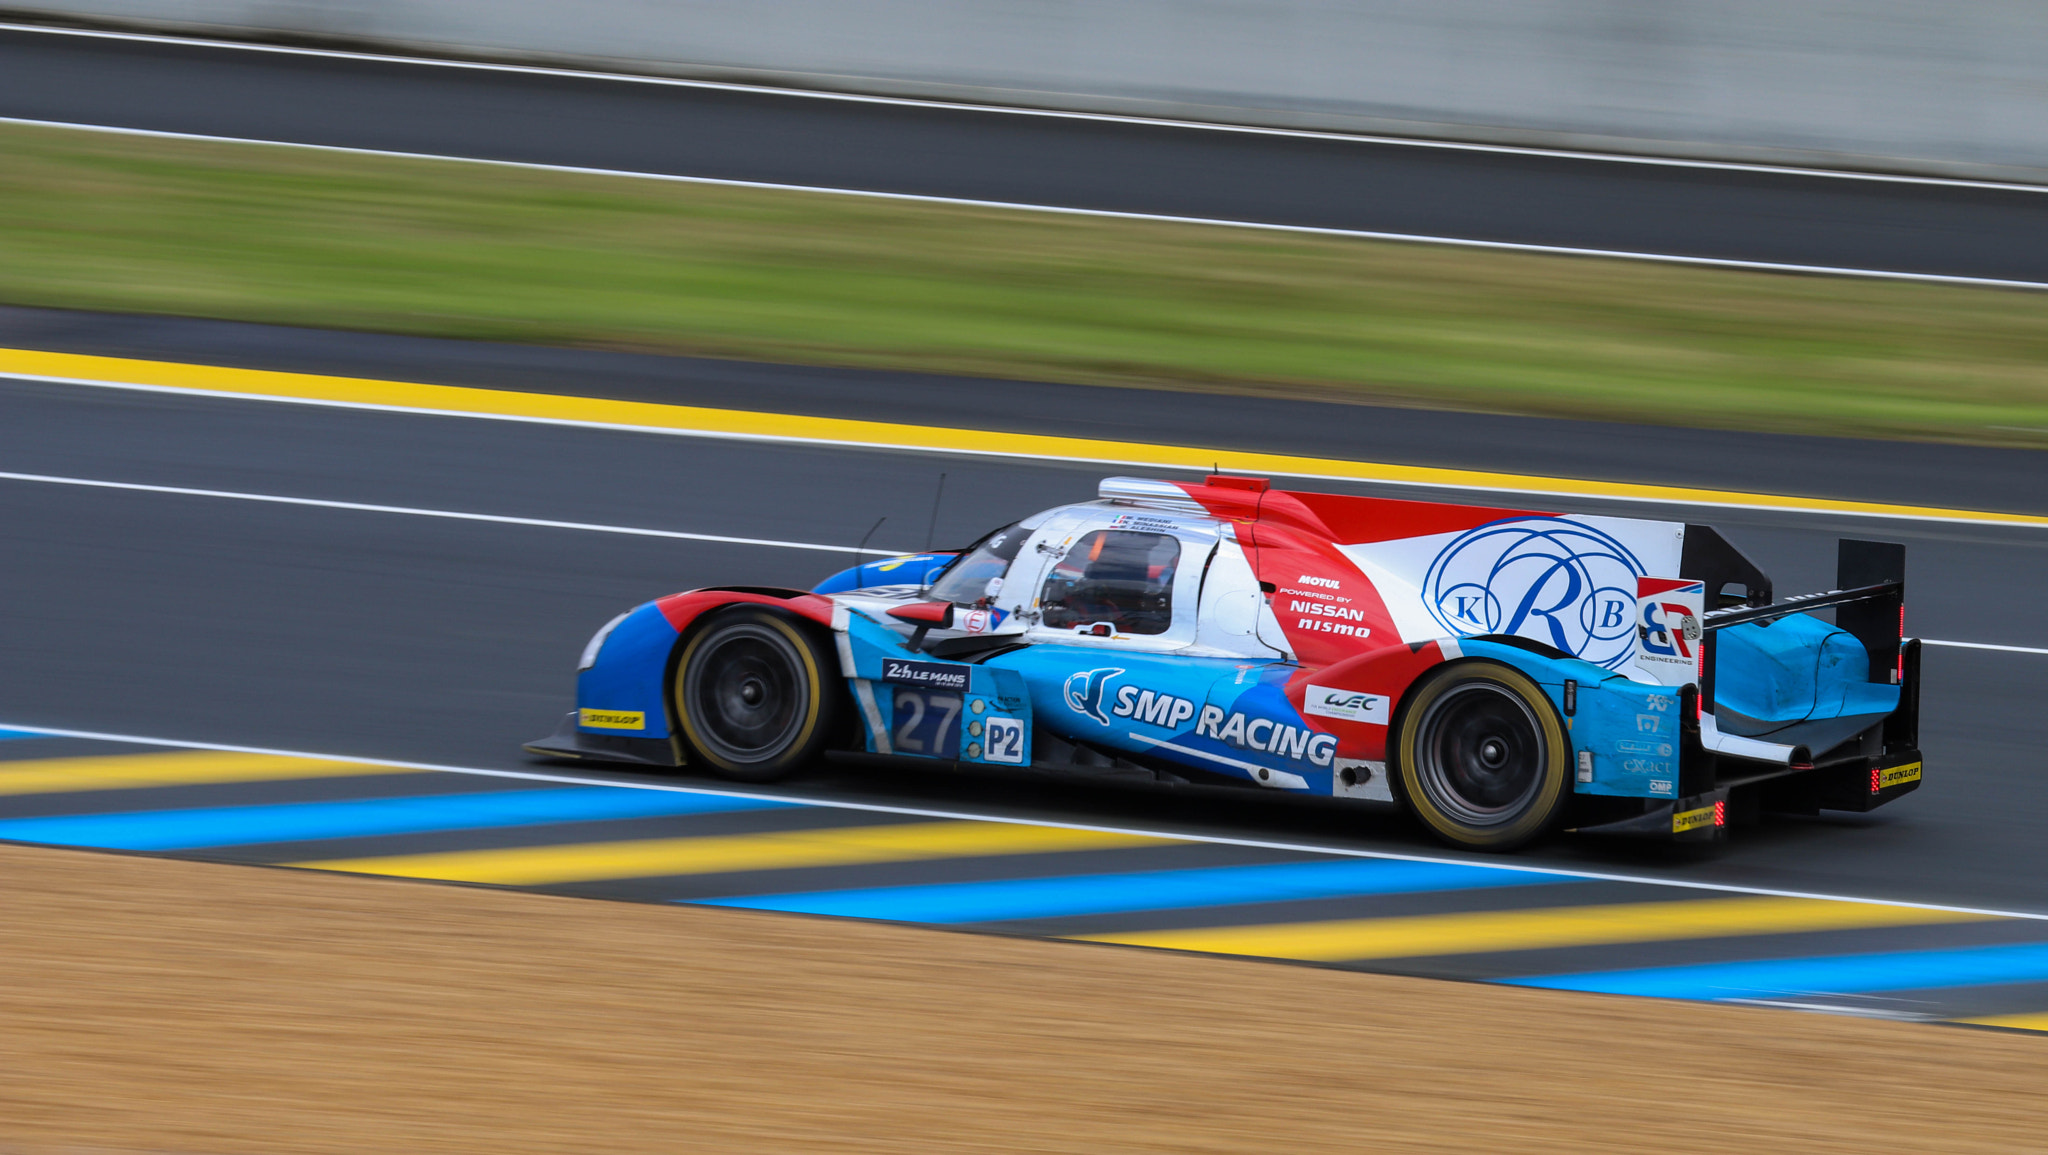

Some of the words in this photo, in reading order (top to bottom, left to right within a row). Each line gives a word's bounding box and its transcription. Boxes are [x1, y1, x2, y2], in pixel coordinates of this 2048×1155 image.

[1297, 574, 1341, 590] MOTUL
[1279, 587, 1335, 601] POWERED
[1336, 596, 1353, 604] BY
[1290, 600, 1364, 622] NISSAN
[1455, 596, 1484, 624] K
[1601, 600, 1625, 628] B
[1298, 618, 1371, 638] nismo
[1640, 654, 1693, 666] ENGINEERING
[912, 670, 930, 680] LE
[929, 672, 966, 684] MANS
[1324, 693, 1378, 711] WEC
[589, 714, 641, 725] DUNLOP
[895, 691, 963, 755] 27
[1113, 685, 1194, 730] SMP
[1195, 703, 1338, 768] RACING
[988, 724, 1020, 757] P2
[1888, 767, 1919, 781] DUNLOP
[1649, 782, 1672, 792] OMP
[1682, 811, 1714, 826] DUNLOP
